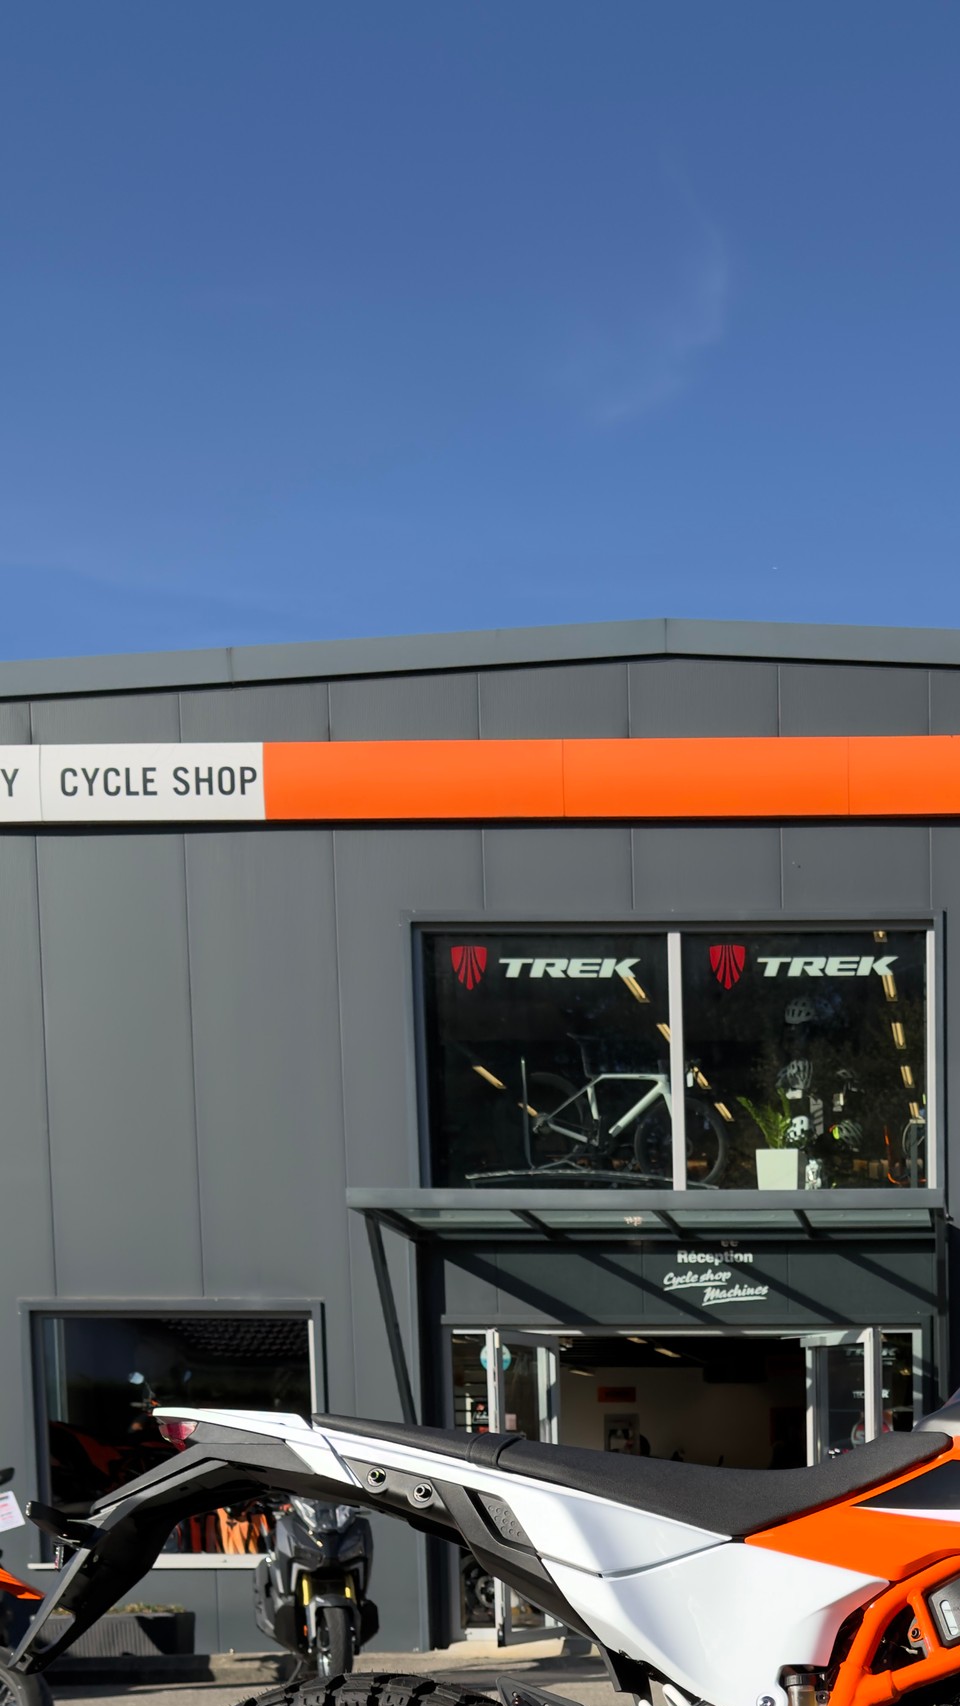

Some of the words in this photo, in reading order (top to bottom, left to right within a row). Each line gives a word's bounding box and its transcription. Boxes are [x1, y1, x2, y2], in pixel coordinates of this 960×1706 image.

[0, 768, 19, 797] Y
[60, 767, 158, 797] CYCLE
[172, 766, 257, 796] SHOP
[499, 958, 641, 978] TREK
[757, 956, 899, 977] TREK
[677, 1250, 753, 1266] Réception
[663, 1271, 698, 1287] Cycle
[699, 1269, 732, 1283] shop
[702, 1284, 769, 1302] Machines
